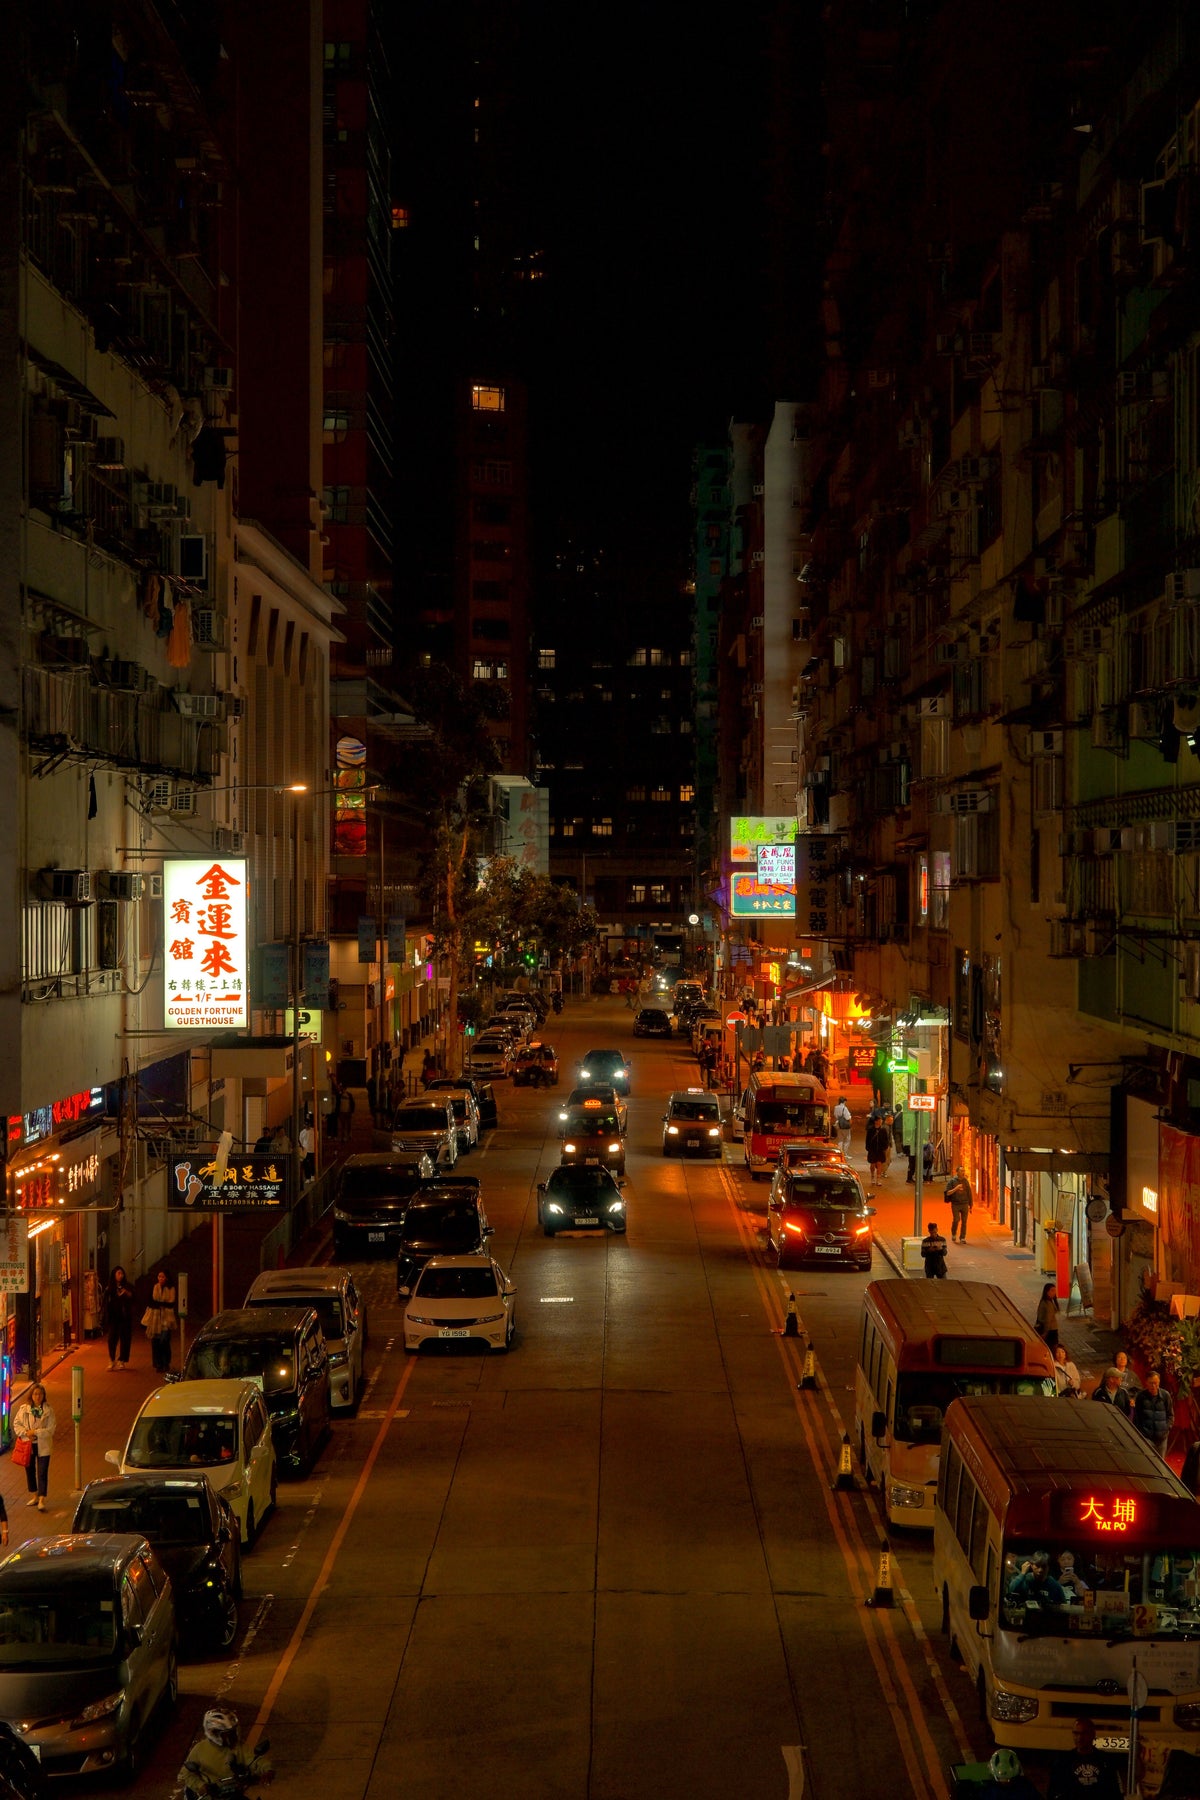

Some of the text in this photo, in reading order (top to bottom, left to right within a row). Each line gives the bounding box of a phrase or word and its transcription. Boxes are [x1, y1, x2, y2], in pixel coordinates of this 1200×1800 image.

[759, 846, 794, 859] 金鳳凰
[196, 863, 241, 978] 金運來
[169, 898, 195, 960] 賓館
[195, 992, 212, 1003] 1/F
[168, 1007, 243, 1015] GOLDEN FORTUNE
[176, 1017, 234, 1025] GUESTHOUSE
[1080, 1496, 1137, 1522] 大埔
[1096, 1521, 1127, 1530] TAI PO
